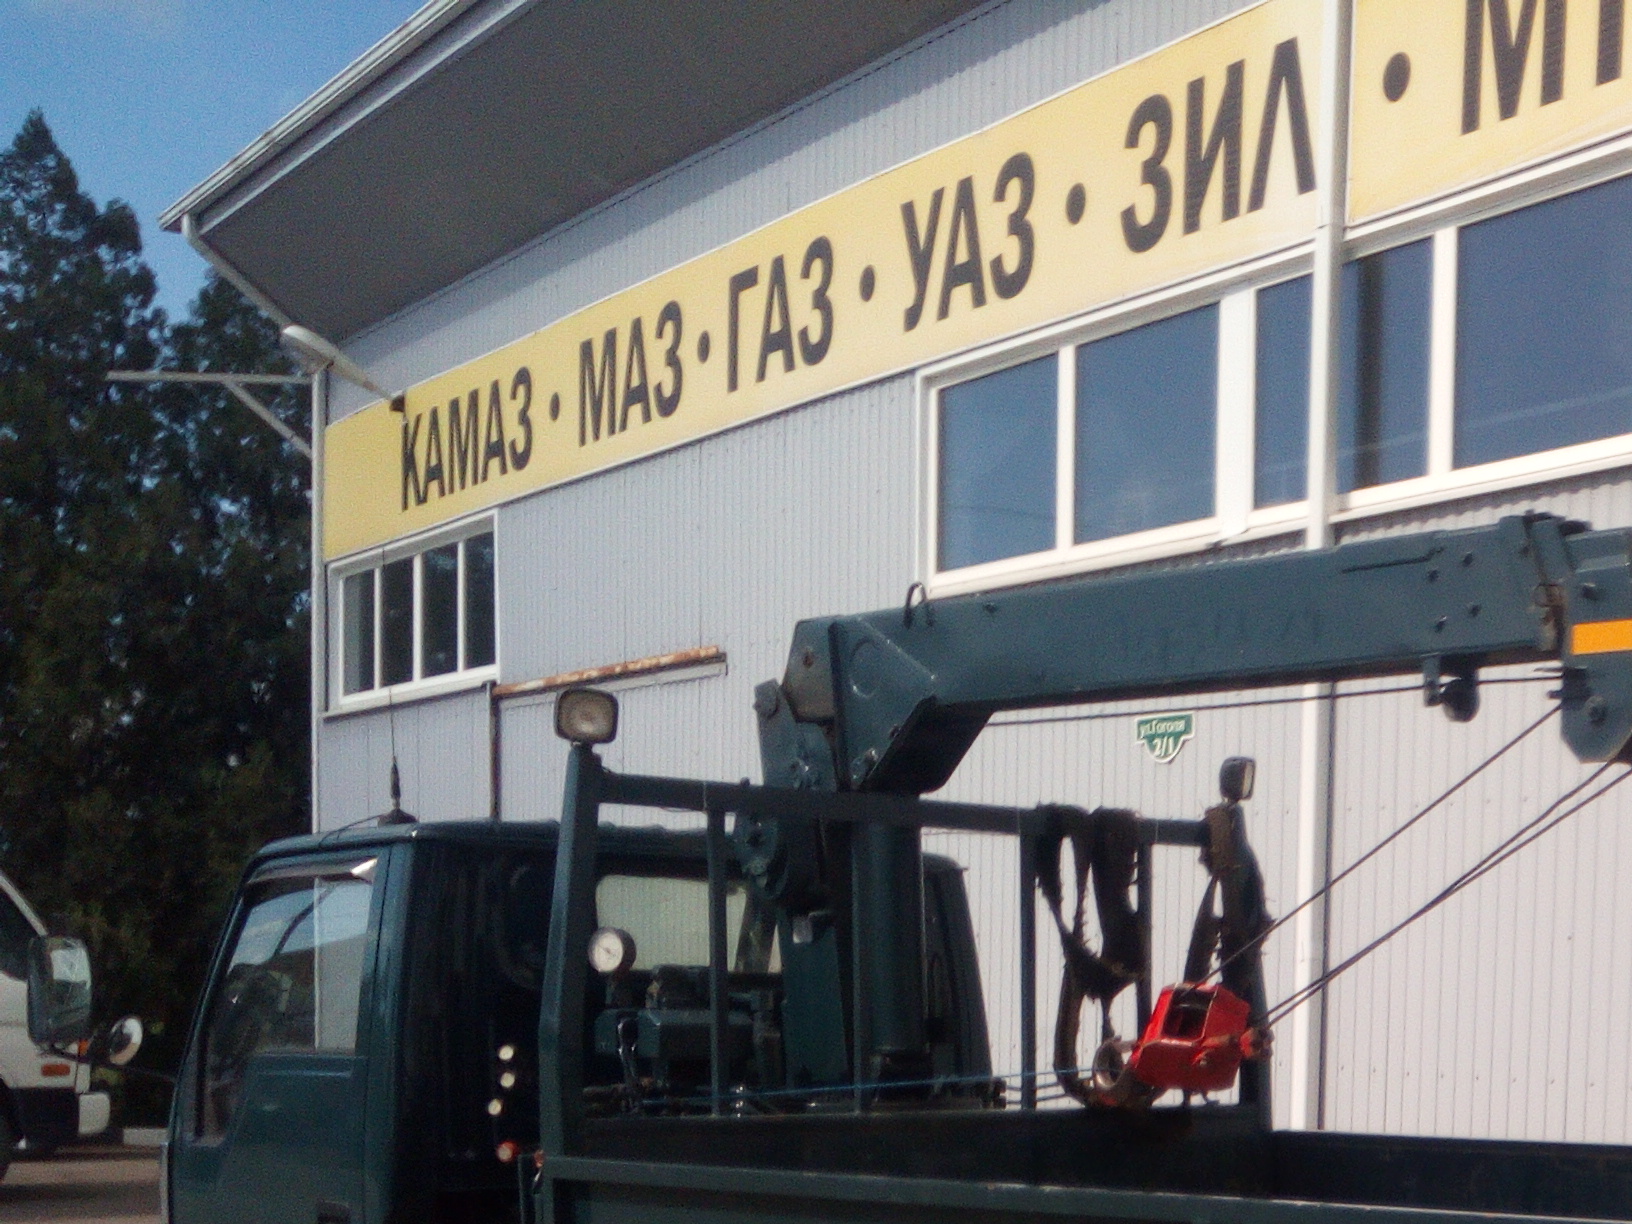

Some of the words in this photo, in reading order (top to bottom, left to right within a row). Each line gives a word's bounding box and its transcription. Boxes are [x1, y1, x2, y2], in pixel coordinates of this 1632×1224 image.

[401, 366, 534, 512] КАМАЗ
[577, 300, 684, 448] МАЗ
[725, 235, 835, 394] ГАЗ
[900, 151, 1036, 333] УАЗ
[1120, 36, 1318, 254] ЗИЛ
